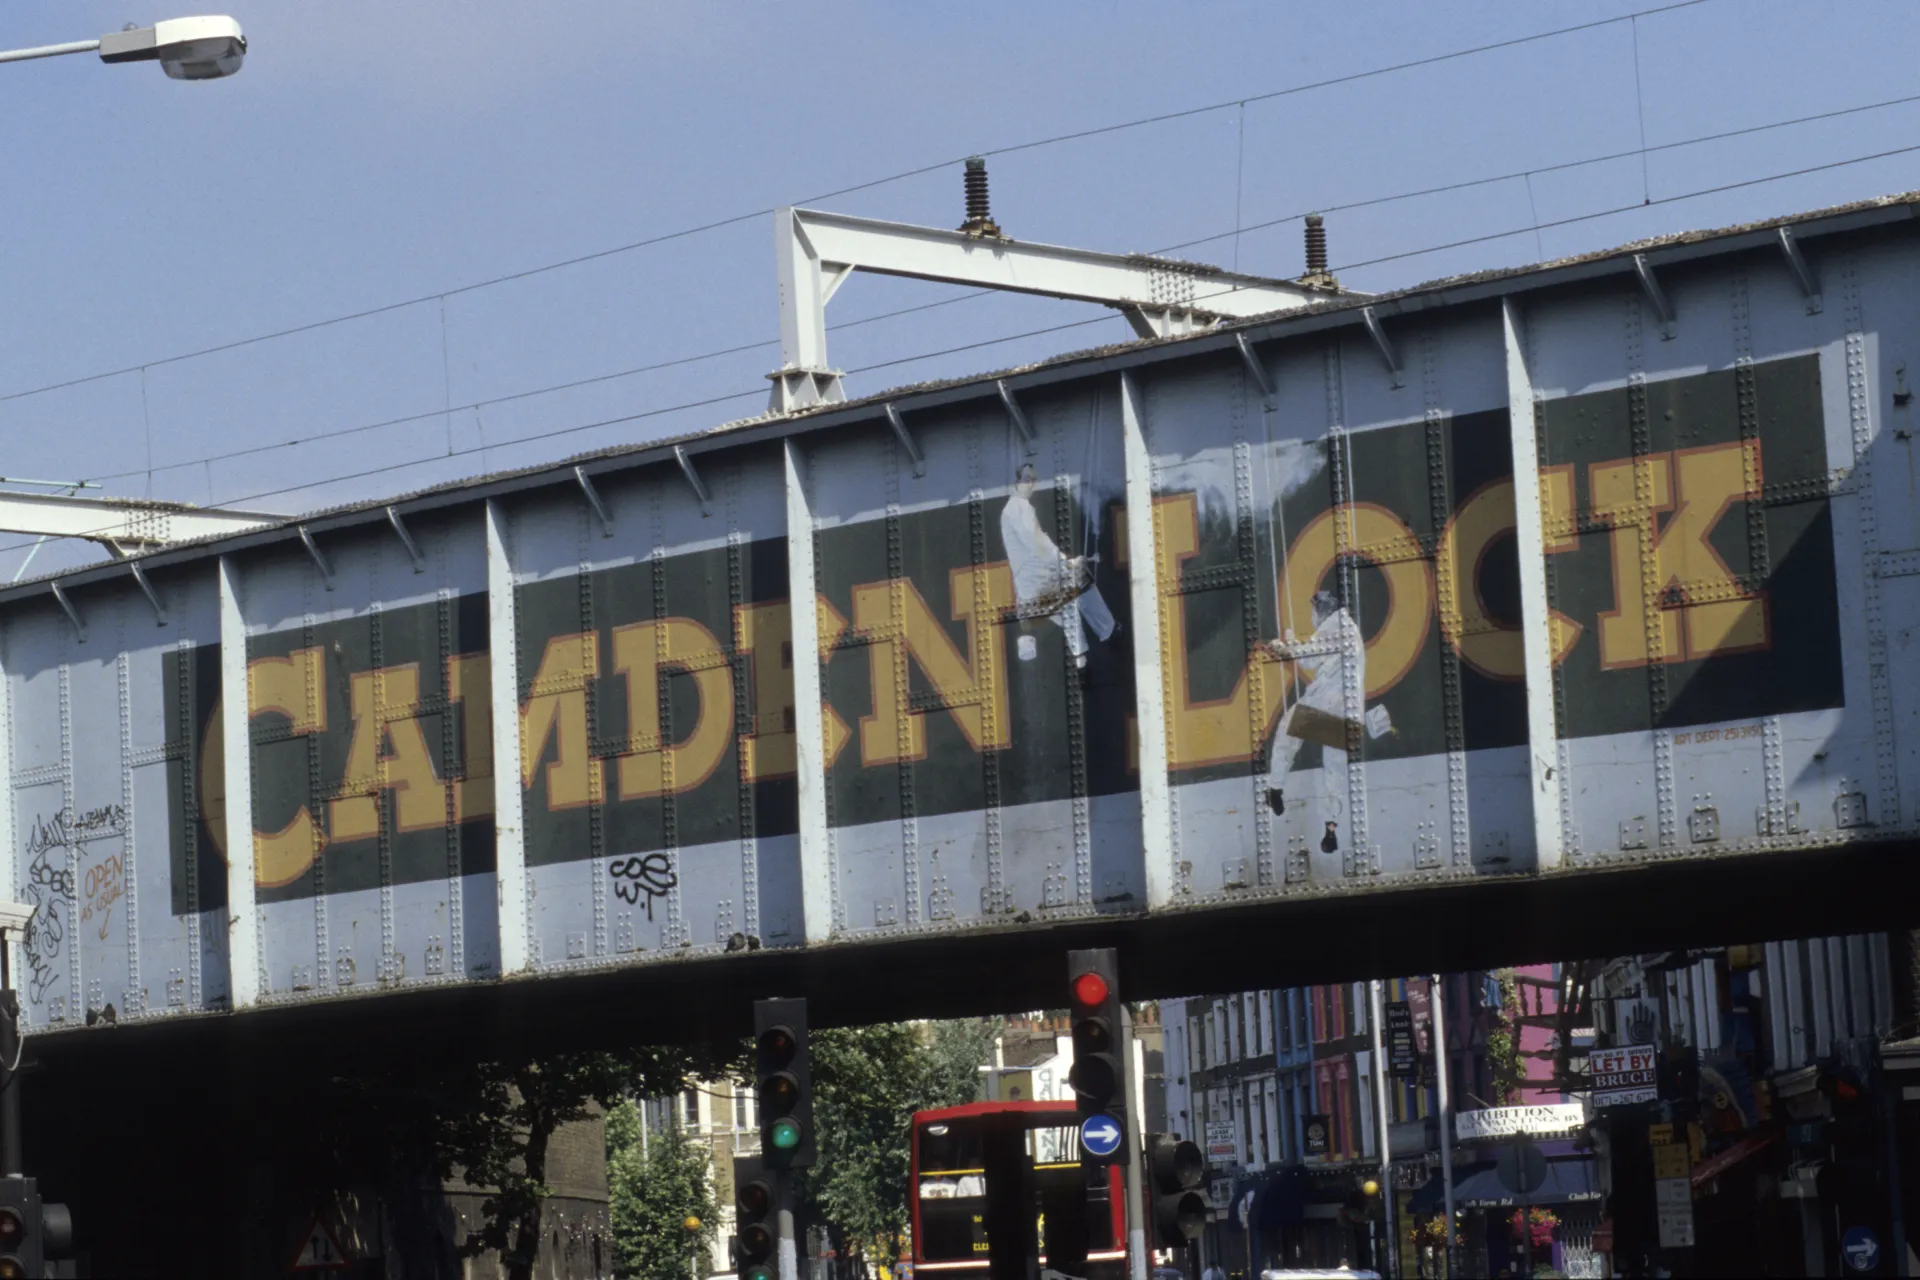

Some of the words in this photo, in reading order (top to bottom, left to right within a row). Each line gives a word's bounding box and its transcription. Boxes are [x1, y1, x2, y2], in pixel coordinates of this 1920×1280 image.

[200, 561, 1016, 888] CAMDEN
[1113, 438, 1771, 772] LOCK
[85, 851, 124, 899] OPEN
[1592, 1056, 1625, 1073] LET
[1630, 1054, 1652, 1070] BY
[1595, 1070, 1654, 1088] BRUCE
[1468, 1106, 1554, 1121] XHIBITION
